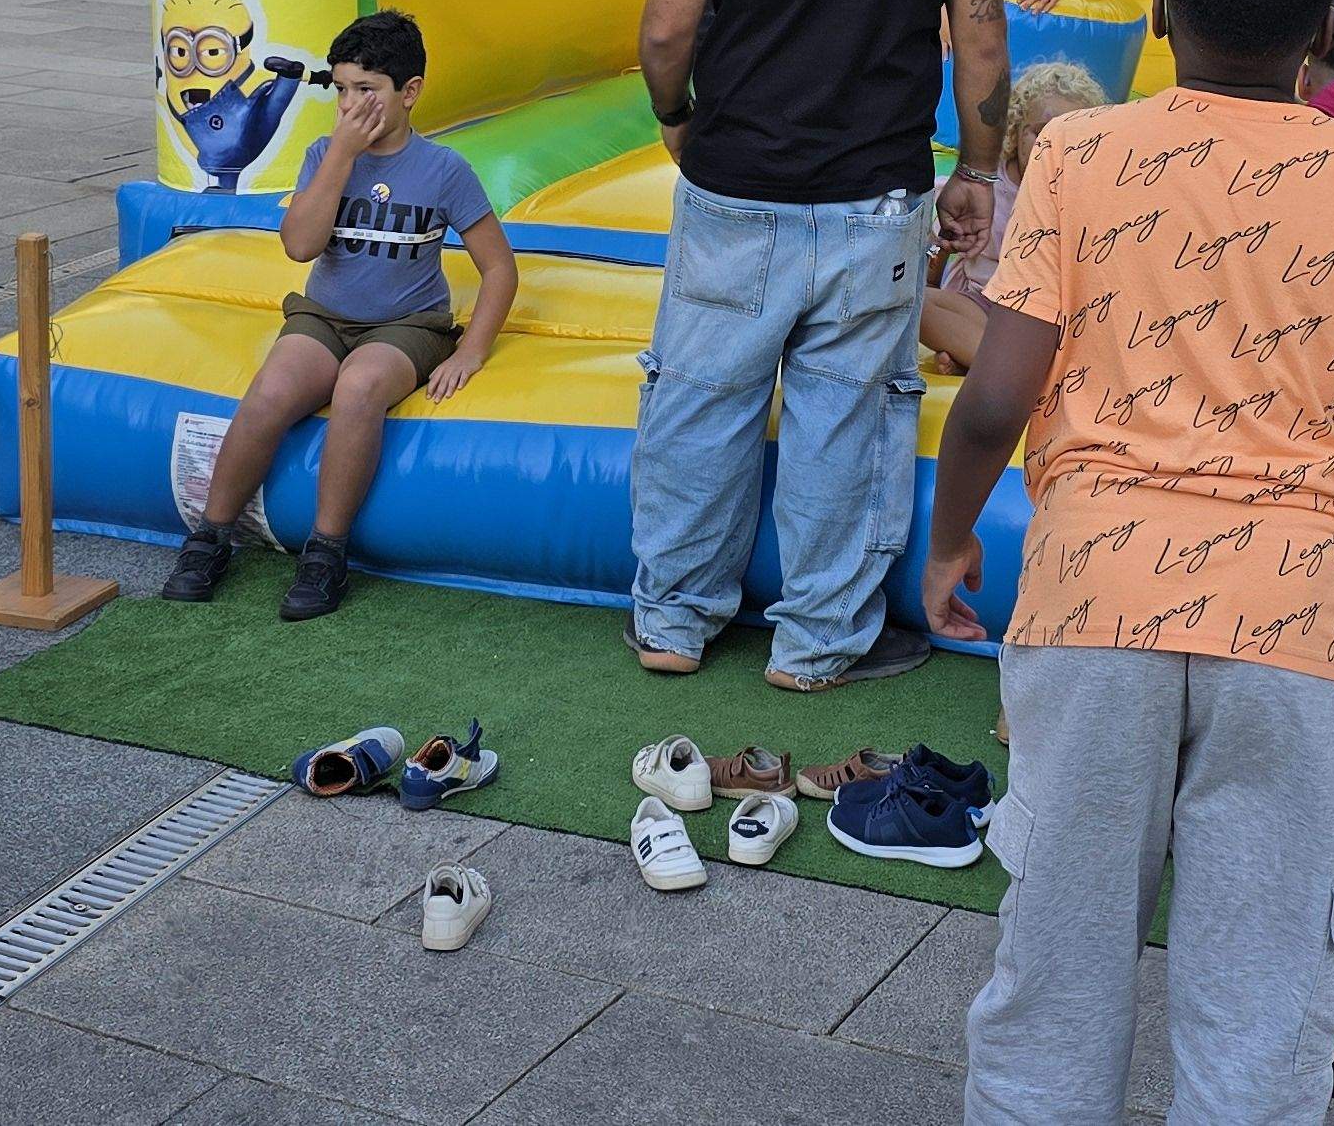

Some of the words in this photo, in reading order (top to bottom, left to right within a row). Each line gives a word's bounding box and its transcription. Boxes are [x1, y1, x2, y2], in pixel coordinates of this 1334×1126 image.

[1116, 137, 1224, 186] Legacy
[1175, 221, 1281, 270] Legacy
[1128, 299, 1226, 349] Legacy
[1231, 314, 1332, 362] Legacy
[1095, 374, 1183, 425] Legacy
[1193, 388, 1283, 433] Legacy
[1060, 518, 1147, 583] Legacy
[1155, 519, 1264, 574] Legacy
[1115, 594, 1218, 650] Legacy
[1231, 601, 1324, 654] Legacy
